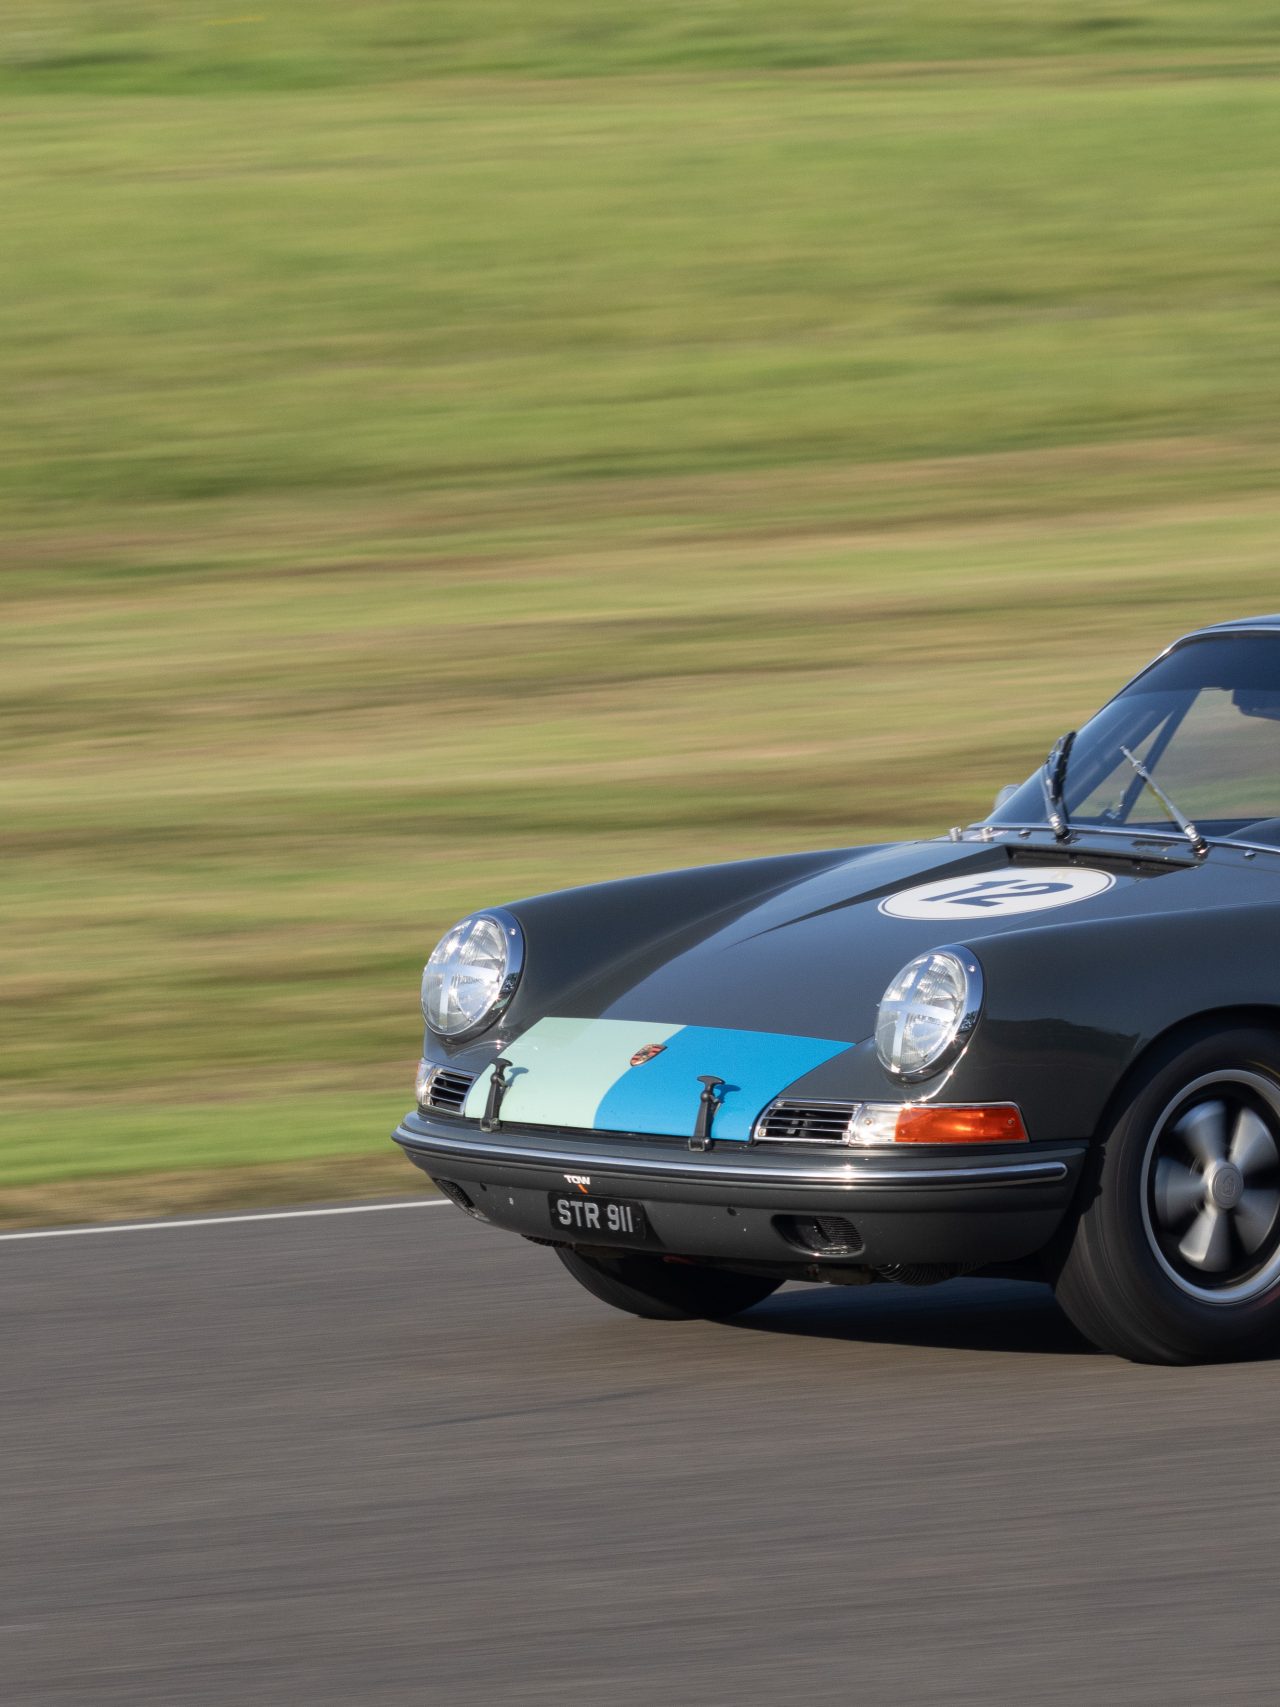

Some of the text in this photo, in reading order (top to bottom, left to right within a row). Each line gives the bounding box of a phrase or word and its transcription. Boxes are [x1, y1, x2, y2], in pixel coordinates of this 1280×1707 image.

[919, 879, 1074, 908] 12
[563, 1174, 591, 1185] TOW
[557, 1199, 634, 1233] STR 911
